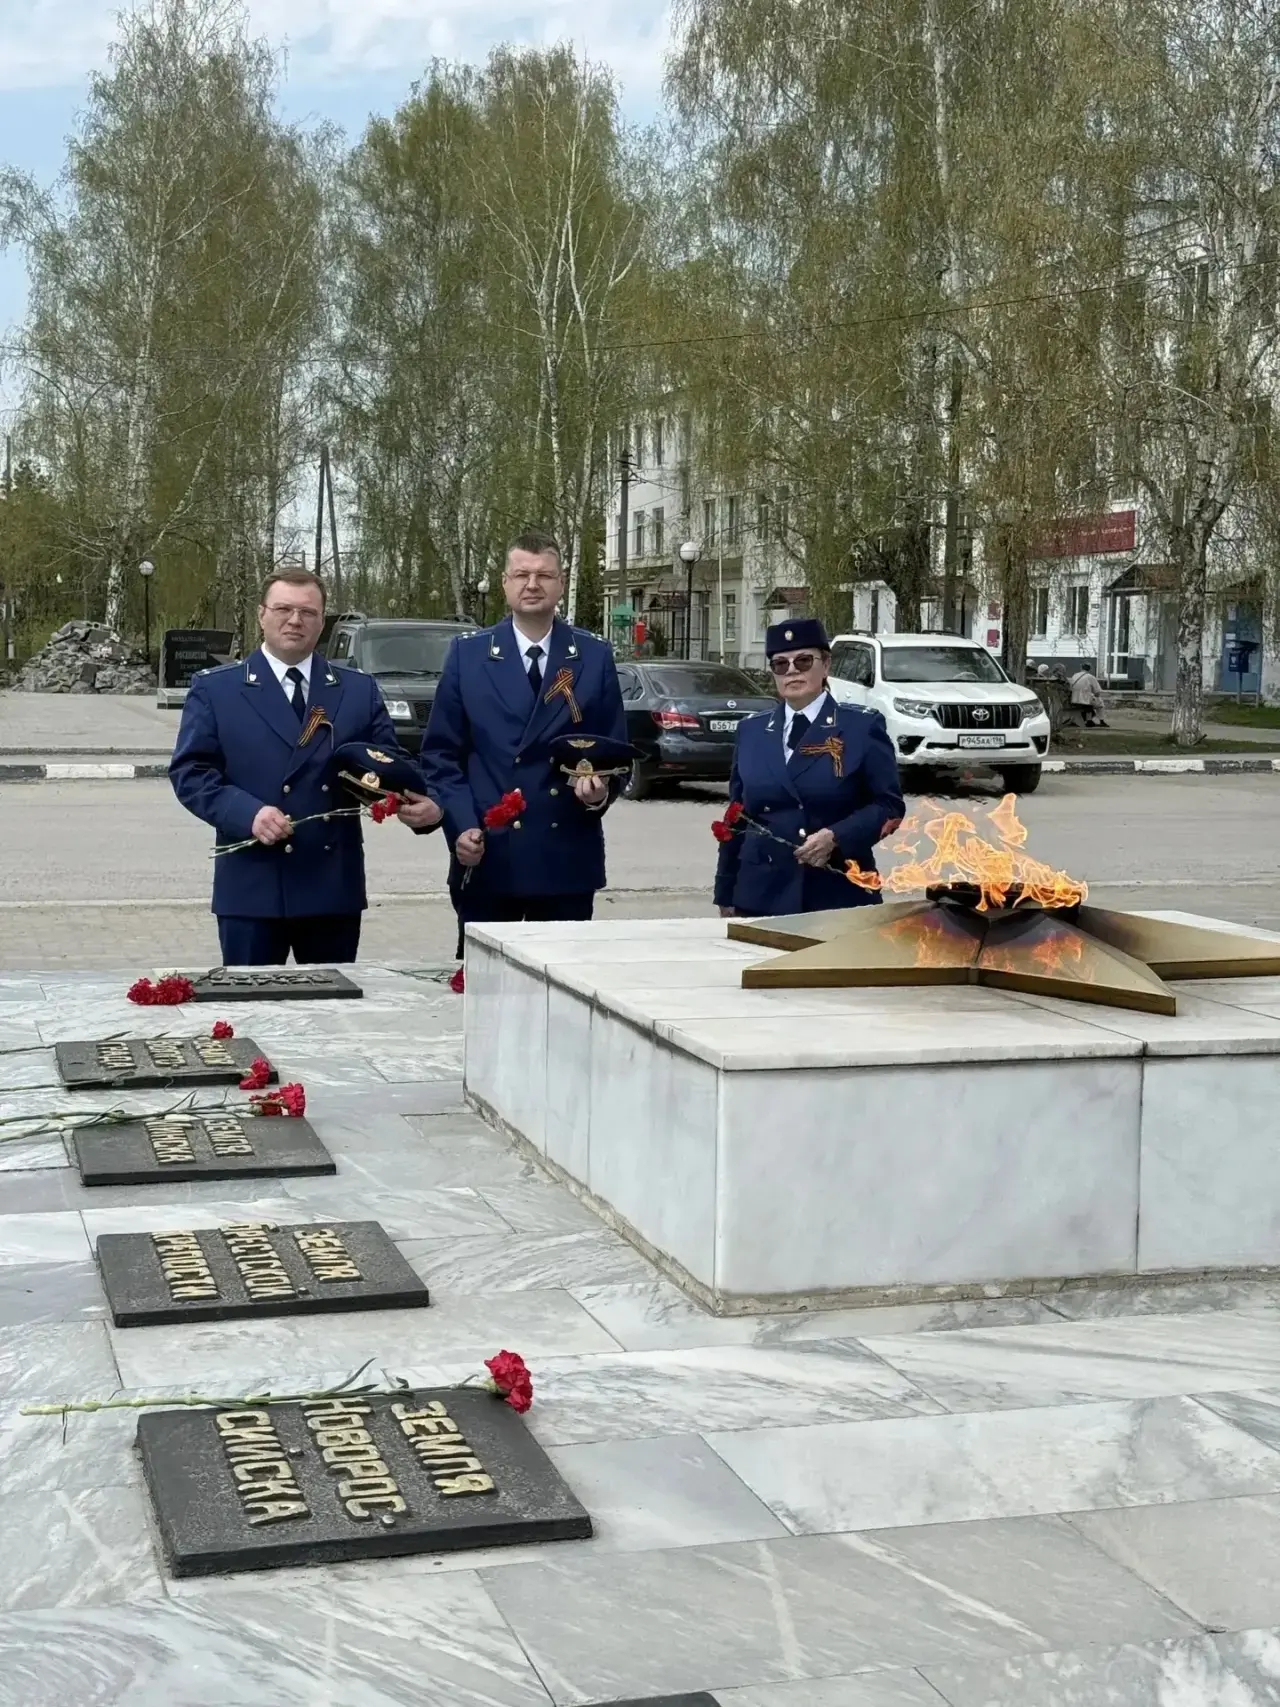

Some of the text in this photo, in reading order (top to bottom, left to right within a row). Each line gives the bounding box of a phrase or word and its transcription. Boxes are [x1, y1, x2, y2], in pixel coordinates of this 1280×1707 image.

[97, 1042, 136, 1069] ГРАДА
[145, 1115, 196, 1163] МИНСКА
[204, 1119, 254, 1155] ЗЕМЛЯ
[151, 1230, 219, 1299] КРЕПОСТИ
[294, 1228, 361, 1280] ЗЕМЛЯ
[391, 1400, 497, 1496] ЗЕМЛЯ
